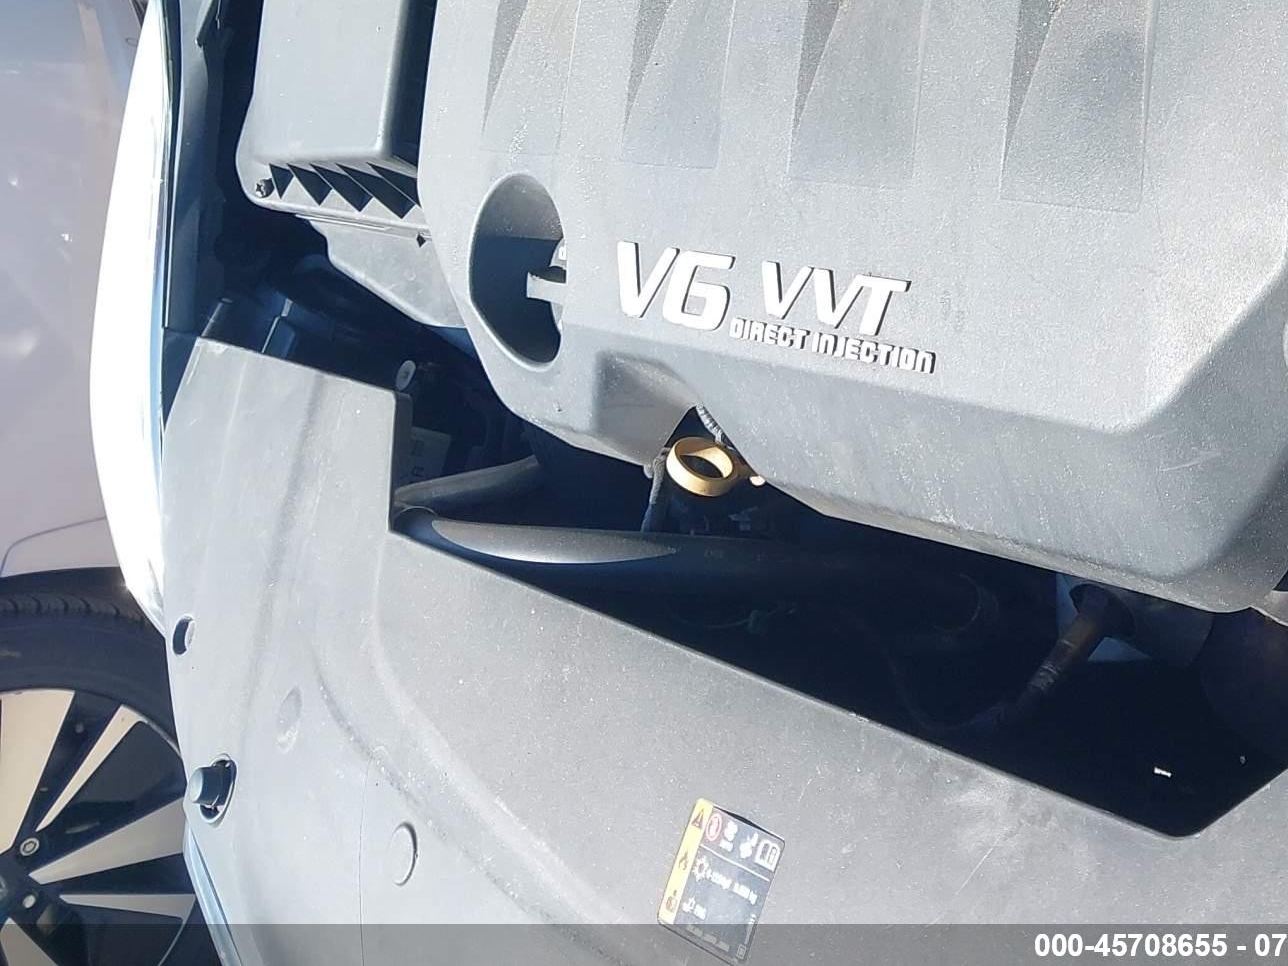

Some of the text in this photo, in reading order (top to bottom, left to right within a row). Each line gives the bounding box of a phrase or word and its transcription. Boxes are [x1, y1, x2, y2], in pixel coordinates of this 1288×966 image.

[616, 241, 911, 336] V6 VVT
[729, 316, 937, 374] DIRECT INJECTION
